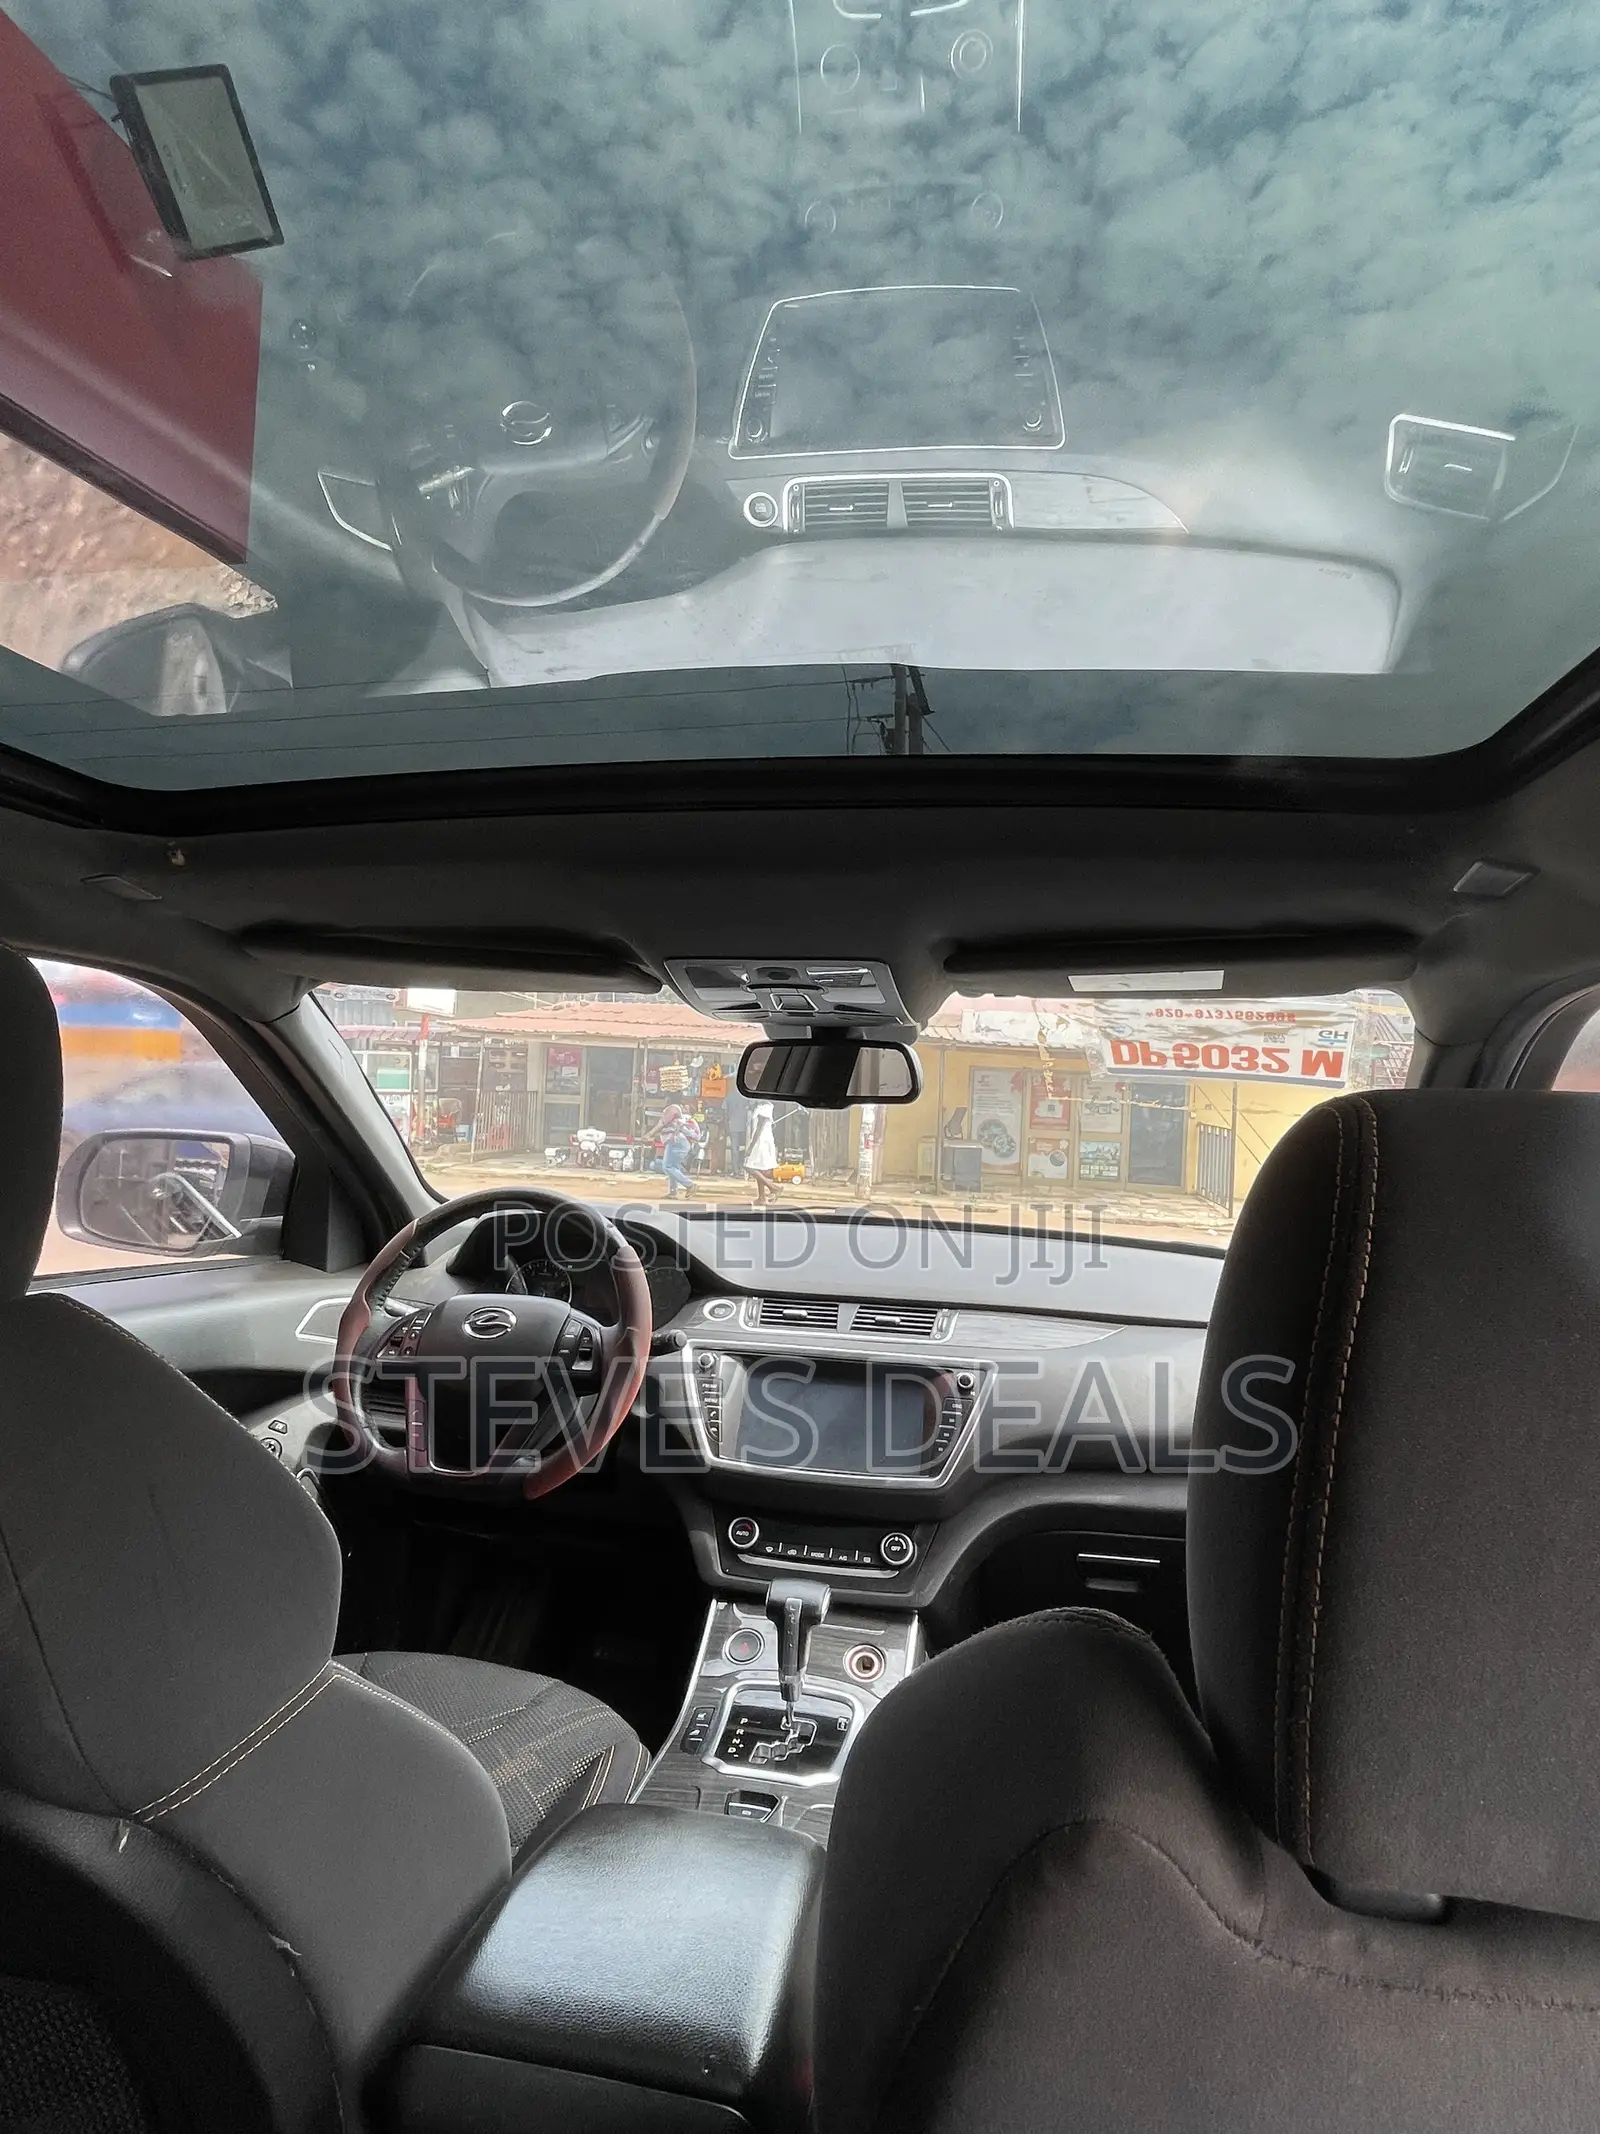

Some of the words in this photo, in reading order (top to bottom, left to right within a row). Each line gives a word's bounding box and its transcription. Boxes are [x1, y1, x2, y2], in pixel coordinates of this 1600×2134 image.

[810, 1551, 825, 1559] MODE
[740, 1717, 749, 1725] P
[736, 1728, 745, 1736] R
[727, 1746, 737, 1754] D
